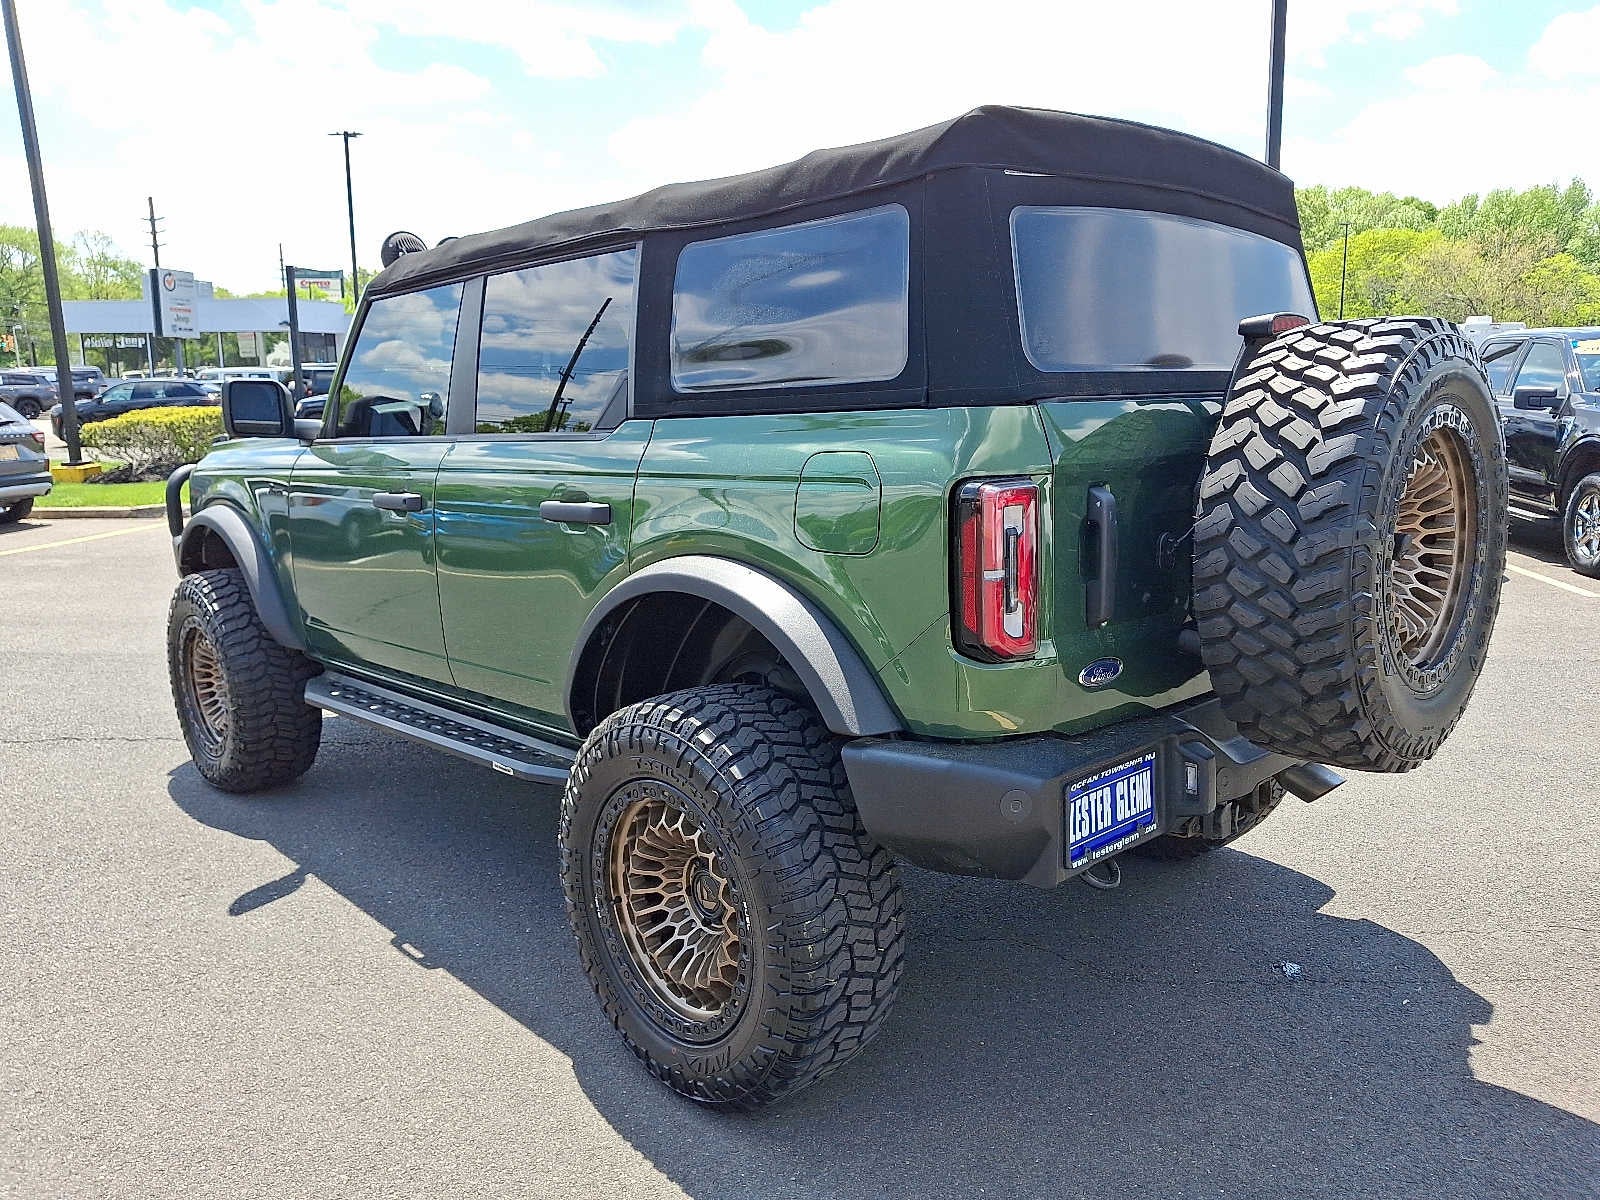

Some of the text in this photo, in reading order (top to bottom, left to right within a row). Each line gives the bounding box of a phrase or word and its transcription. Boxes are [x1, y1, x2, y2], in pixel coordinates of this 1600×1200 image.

[1071, 774, 1099, 791] OCEAN
[1145, 752, 1156, 760] NJ
[1069, 770, 1152, 844] LESTER GLENN
[1092, 832, 1139, 860] lesterglenn
